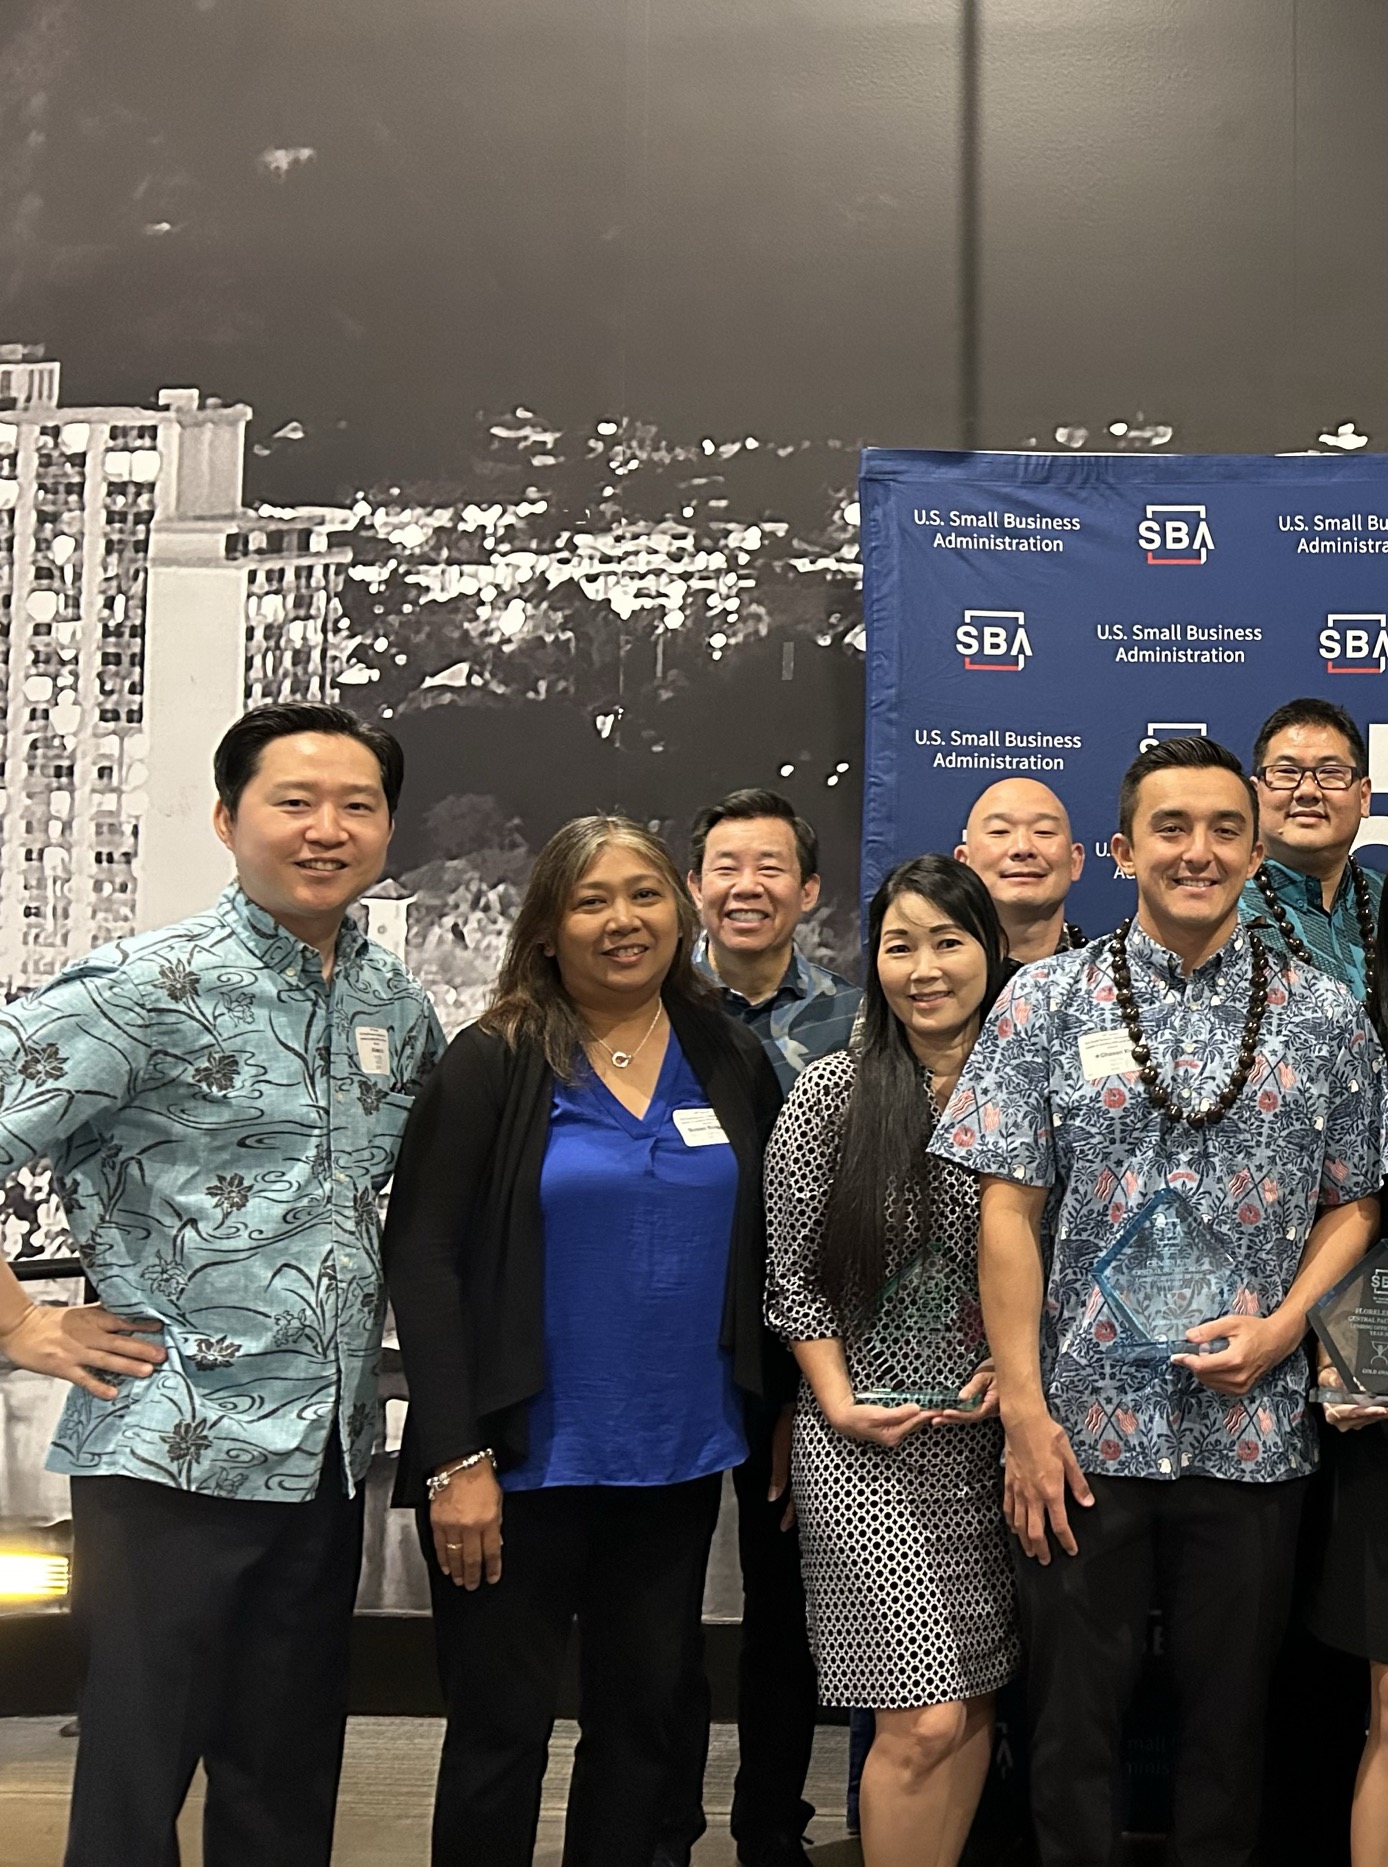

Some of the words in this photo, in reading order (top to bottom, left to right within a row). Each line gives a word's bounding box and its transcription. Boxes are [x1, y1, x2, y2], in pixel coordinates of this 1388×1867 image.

[913, 508, 945, 527] U.S.
[949, 510, 999, 529] Small
[1003, 512, 1081, 531] Business
[1278, 514, 1309, 532] U.S.
[1313, 513, 1363, 532] Small
[932, 531, 1064, 552] Administration
[1138, 521, 1215, 551] SBA
[956, 626, 1032, 657] SBA
[1096, 624, 1128, 641] U.S.
[1132, 623, 1182, 641] Small
[1186, 624, 1263, 641] Business
[1115, 645, 1245, 663] Administration
[915, 729, 946, 746] U.S.
[950, 730, 1001, 747] Small
[1004, 731, 1082, 749] Business
[932, 751, 1064, 771] Administration
